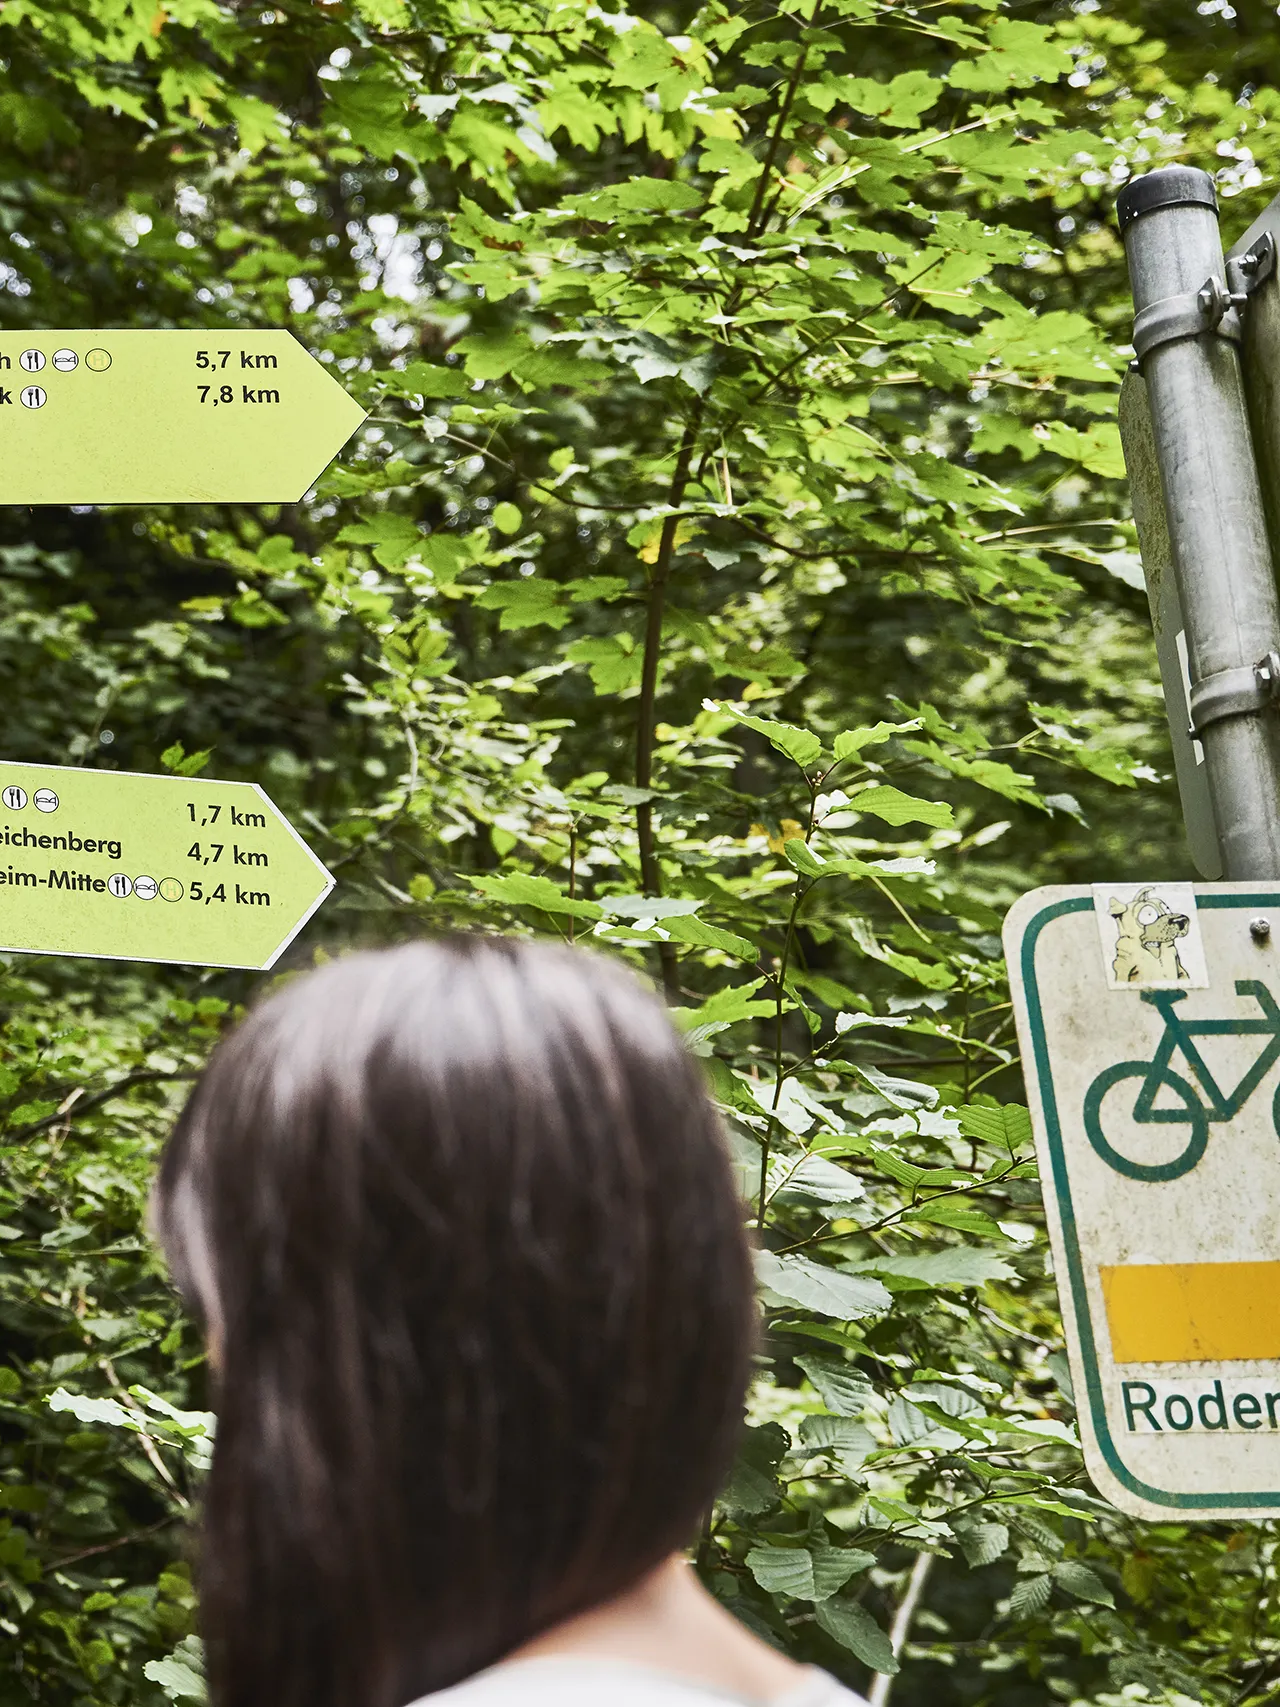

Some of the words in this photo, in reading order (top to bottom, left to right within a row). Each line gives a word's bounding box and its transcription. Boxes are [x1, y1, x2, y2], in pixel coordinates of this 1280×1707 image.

[195, 351, 231, 371] 5,7
[240, 351, 278, 369] km
[197, 385, 234, 406] 7,8
[242, 385, 280, 403] km
[186, 803, 222, 826] 1,7
[230, 806, 266, 827] km
[187, 842, 224, 866] 4,7
[233, 845, 269, 867] km
[189, 881, 227, 905] 5,4
[235, 884, 271, 906] km
